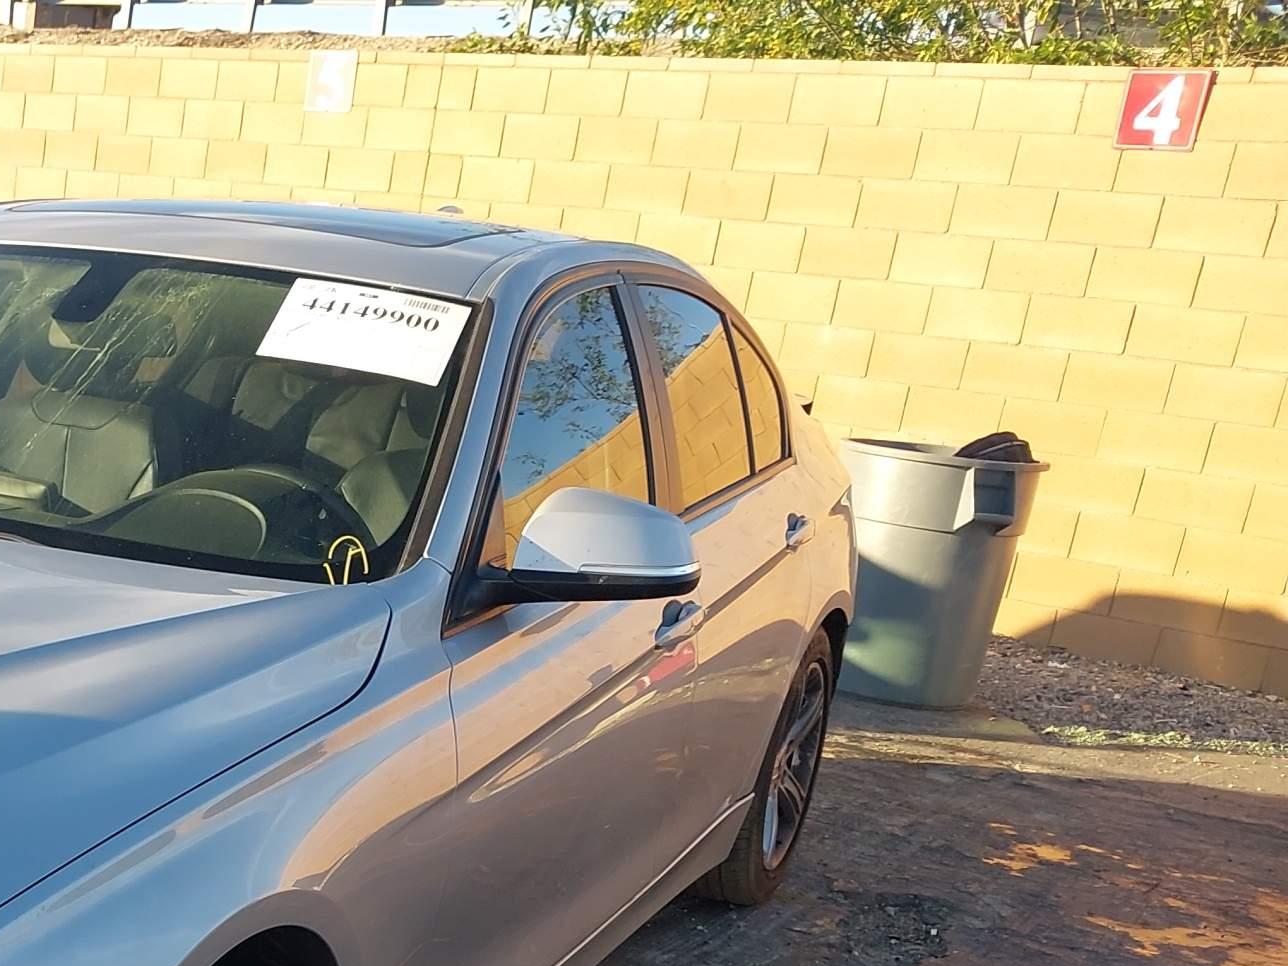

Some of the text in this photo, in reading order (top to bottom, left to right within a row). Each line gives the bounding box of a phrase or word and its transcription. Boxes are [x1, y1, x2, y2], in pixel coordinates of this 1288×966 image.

[315, 52, 346, 109] 5
[1132, 73, 1182, 145] 4
[302, 297, 440, 332] 44149900
